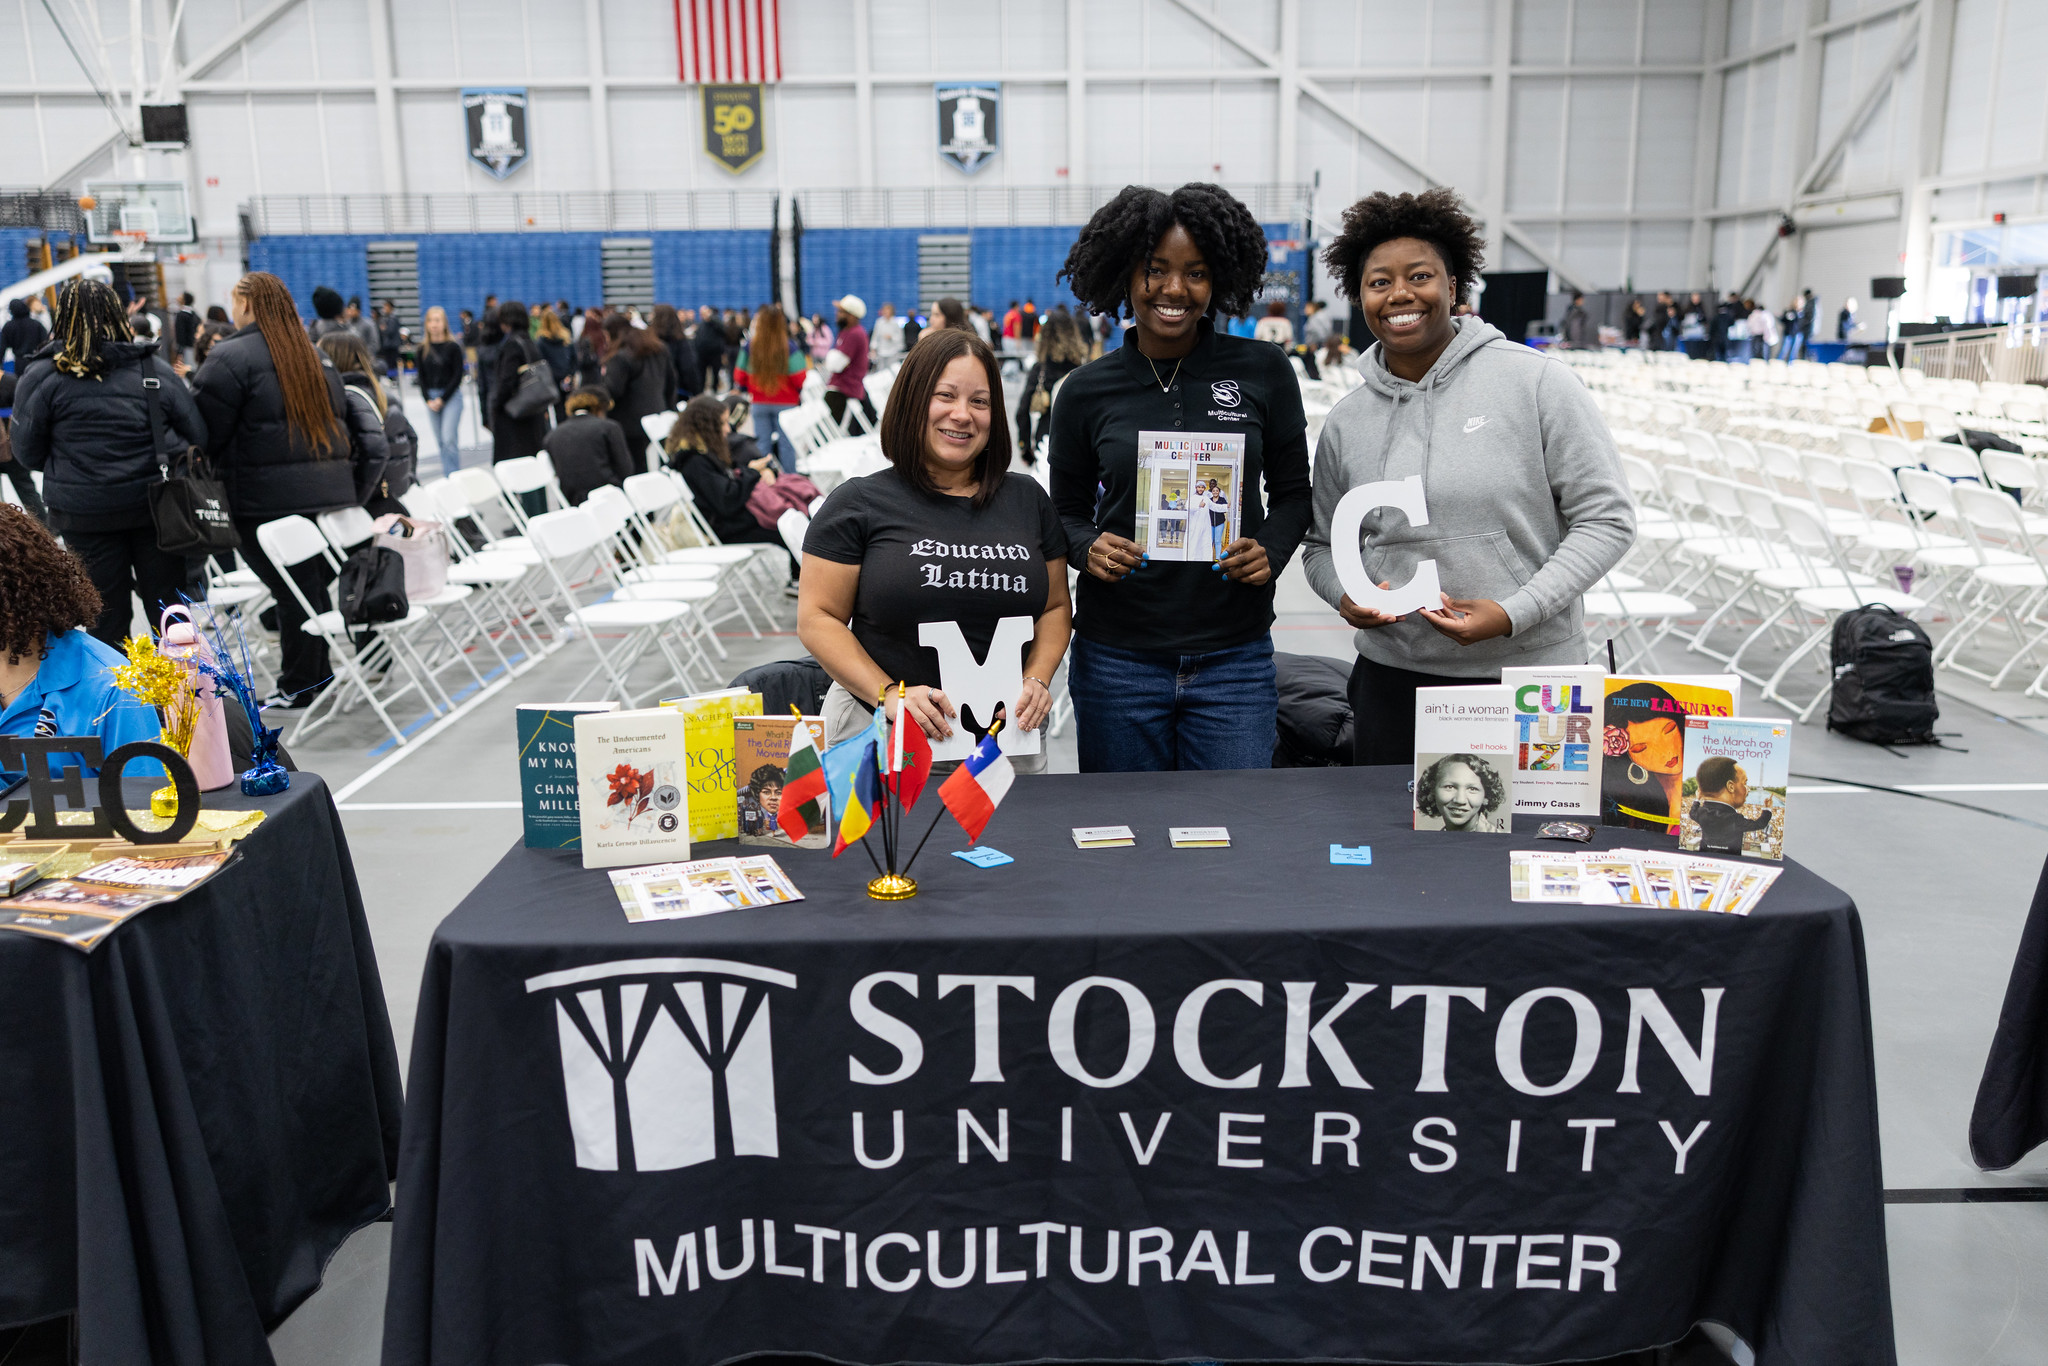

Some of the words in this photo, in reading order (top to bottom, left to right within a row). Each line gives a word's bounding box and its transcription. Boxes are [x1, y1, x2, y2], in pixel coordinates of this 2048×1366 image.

[714, 105, 754, 134] 50
[1208, 410, 1248, 418] Multicultural
[1466, 415, 1486, 428] NIKE
[1171, 451, 1211, 462] CENTER
[909, 538, 1031, 561] Educated
[1330, 474, 1444, 617] C
[920, 563, 1029, 594] Latina
[918, 615, 1041, 763] M
[1515, 684, 1593, 714] CUL
[1424, 704, 1449, 714] ain't
[1457, 706, 1465, 714] a
[1468, 705, 1509, 715] woman
[1612, 697, 1629, 706] THE
[1630, 699, 1650, 708] NEW
[1650, 697, 1728, 717] LATINA'S
[683, 713, 723, 724] ANACHE
[766, 730, 784, 739] What
[1514, 714, 1592, 743] TUR
[597, 736, 610, 744] The
[613, 733, 666, 743] Undocumented
[747, 738, 762, 748] the
[763, 738, 783, 748] Civil
[1702, 735, 1719, 745] the
[1722, 736, 1756, 748] March
[1759, 740, 1773, 749] on
[612, 747, 652, 755] Americans
[1485, 743, 1508, 751] hooks
[1702, 746, 1771, 760] Washington?
[528, 757, 547, 768] MY
[554, 758, 574, 769] NA
[686, 747, 736, 768] YOU
[1518, 743, 1589, 772] IZE
[534, 784, 575, 794] CHAN
[687, 777, 738, 795] NOU
[539, 800, 580, 811] MILLE
[1515, 799, 1548, 808] Jimmy
[1550, 800, 1580, 808] Casas
[615, 840, 638, 848] Cornejo
[639, 837, 677, 846] Villavicencio
[848, 971, 1726, 1097] STOCKTON
[852, 1106, 1711, 1174] UNIVERSITY
[634, 1218, 1275, 1297] MULTICULTURAL
[1299, 1226, 1622, 1292] CENTER
